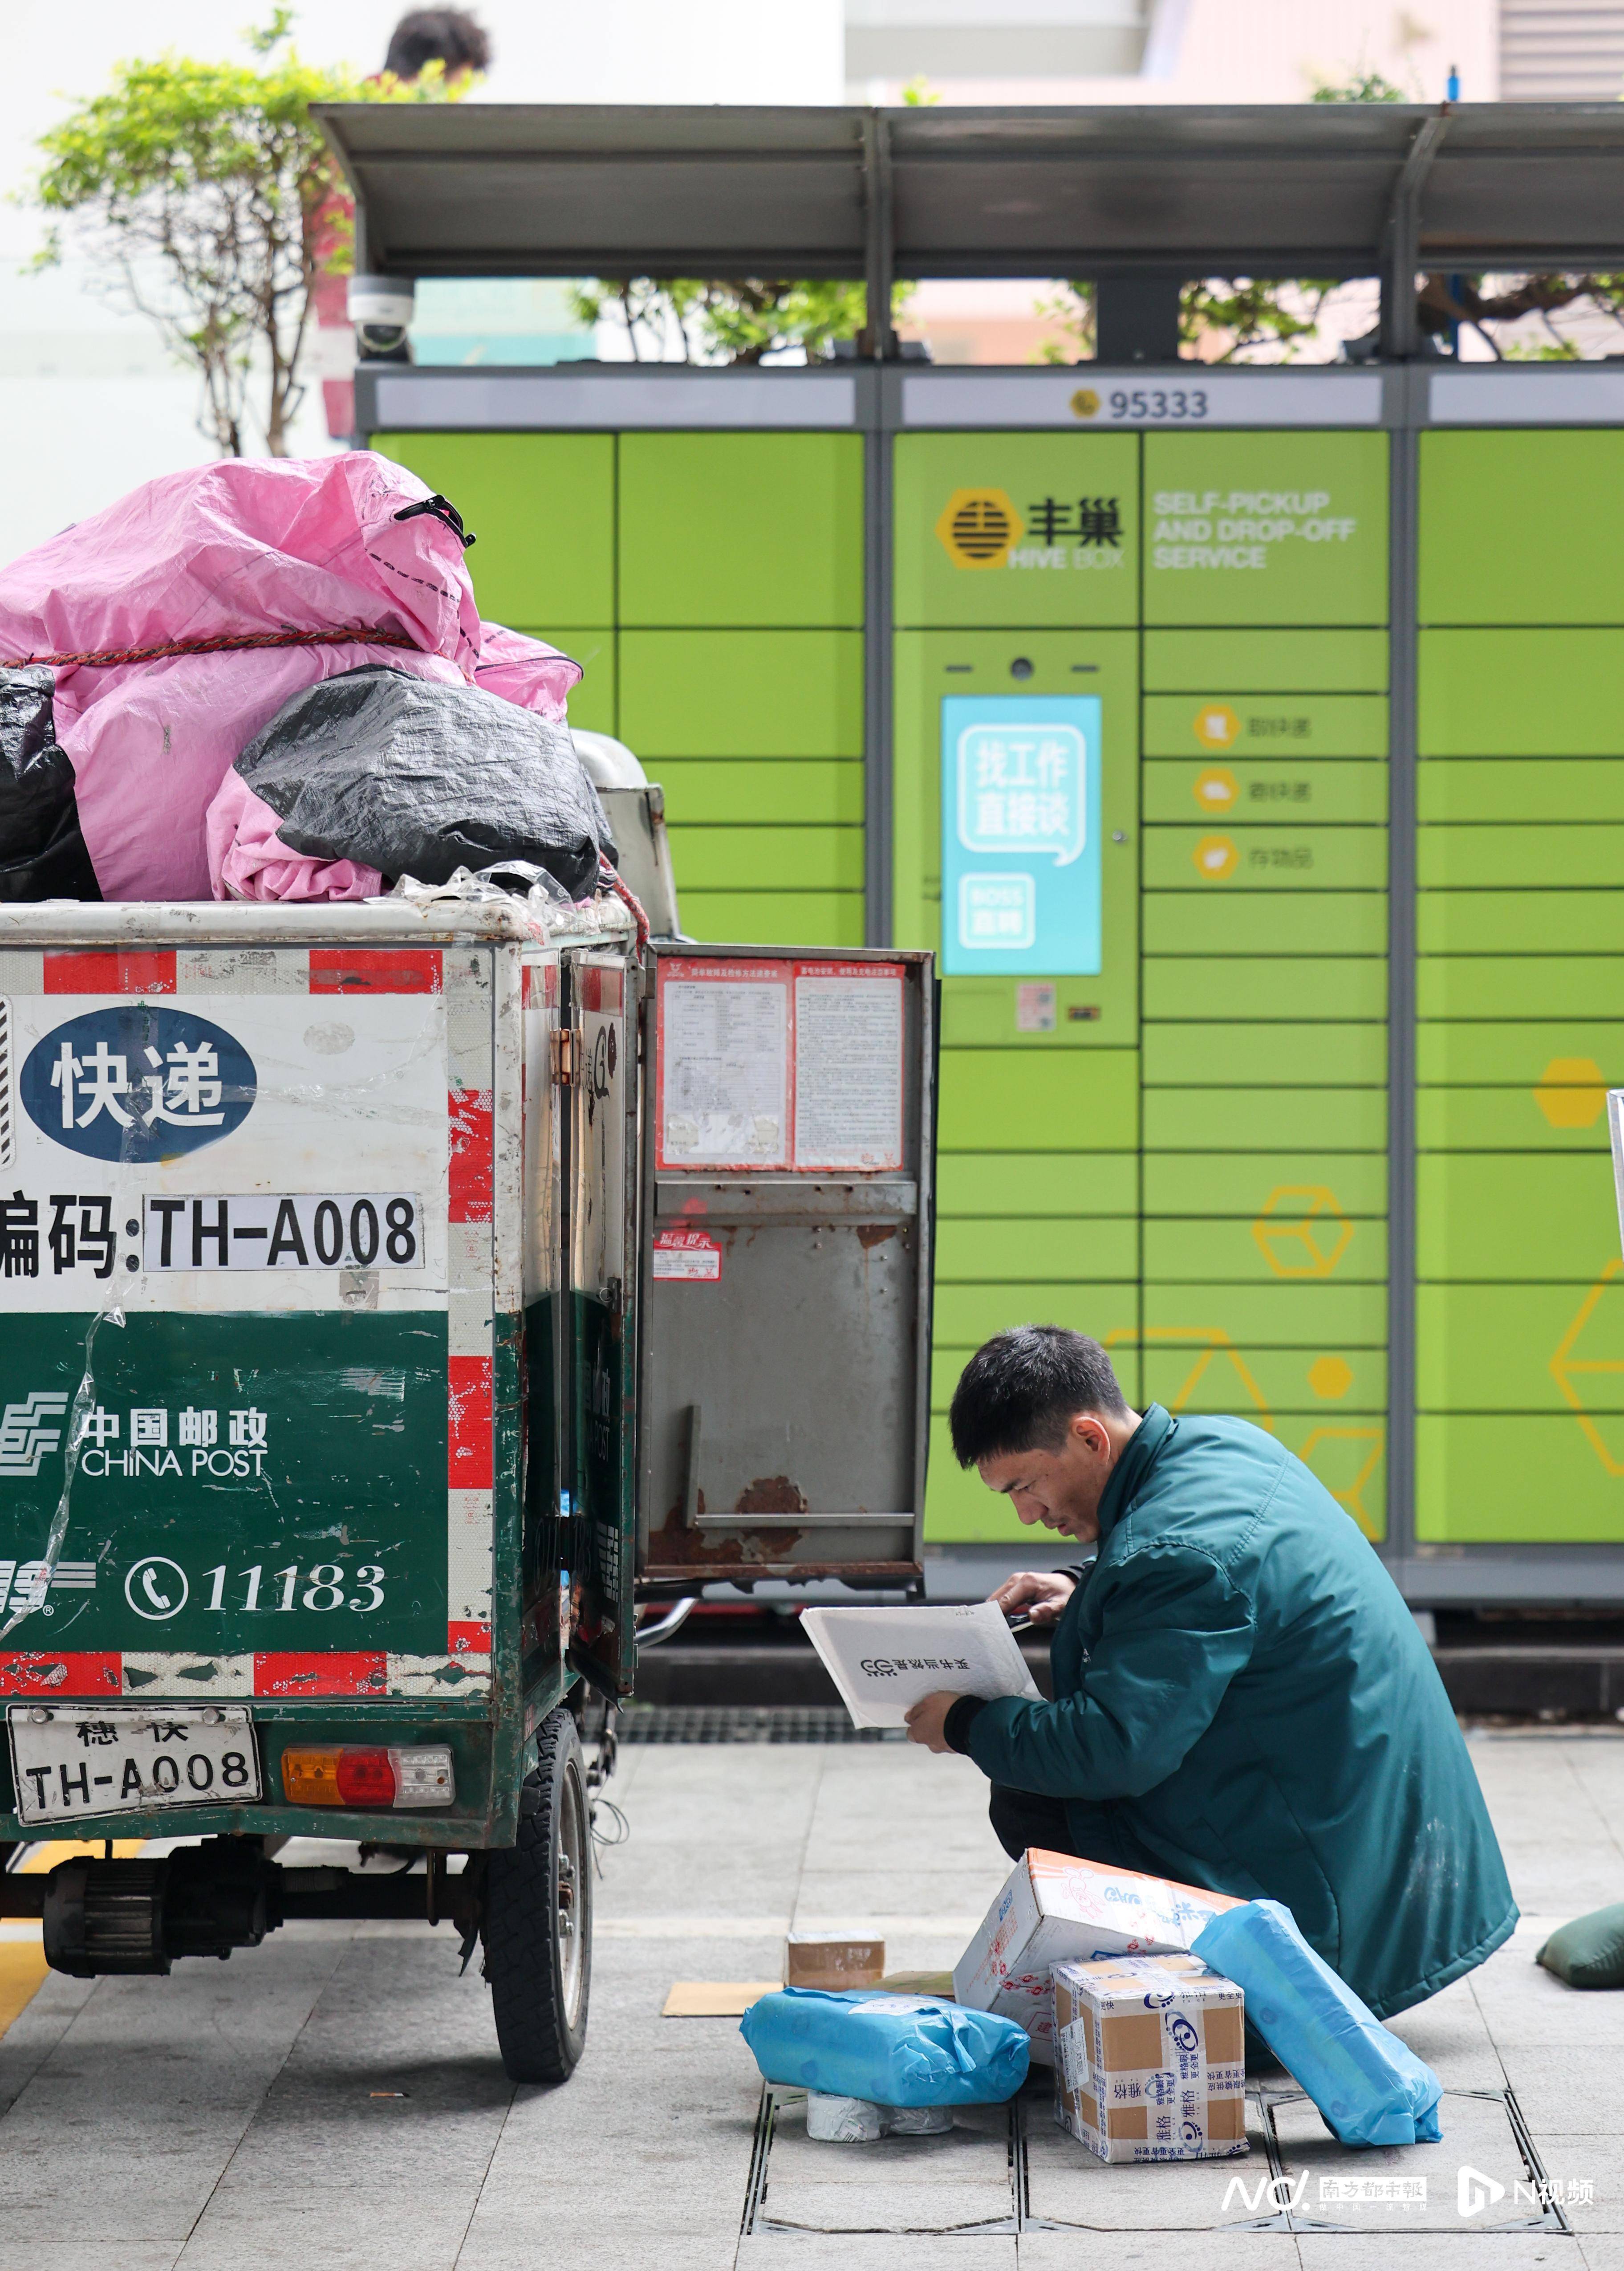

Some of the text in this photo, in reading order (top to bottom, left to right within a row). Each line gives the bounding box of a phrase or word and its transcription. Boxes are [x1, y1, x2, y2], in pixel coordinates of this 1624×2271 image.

[1110, 391, 1208, 419] 95333
[1154, 492, 1330, 515] SELF-PICKUP
[1028, 497, 1124, 547] 丰巢
[1154, 517, 1355, 541] AND DROP-OFF
[1007, 548, 1125, 570] HIVE BOX
[1154, 545, 1266, 569] SERVICE
[976, 740, 1069, 787] 找工作
[976, 791, 1070, 835] 直接谈
[51, 1042, 225, 1129] 快递
[150, 1198, 416, 1267] TH-A008
[660, 1232, 712, 1249] 温馨提示
[81, 1406, 268, 1449] 中国邮政
[81, 1449, 267, 1477] CHINA POST
[202, 1564, 386, 1613] 11183
[25, 1752, 249, 1810] TH-A008
[1114, 2082, 1142, 2100] 雅格
[1180, 2090, 1195, 2118] 雅格
[1156, 2115, 1171, 2142] 雅格
